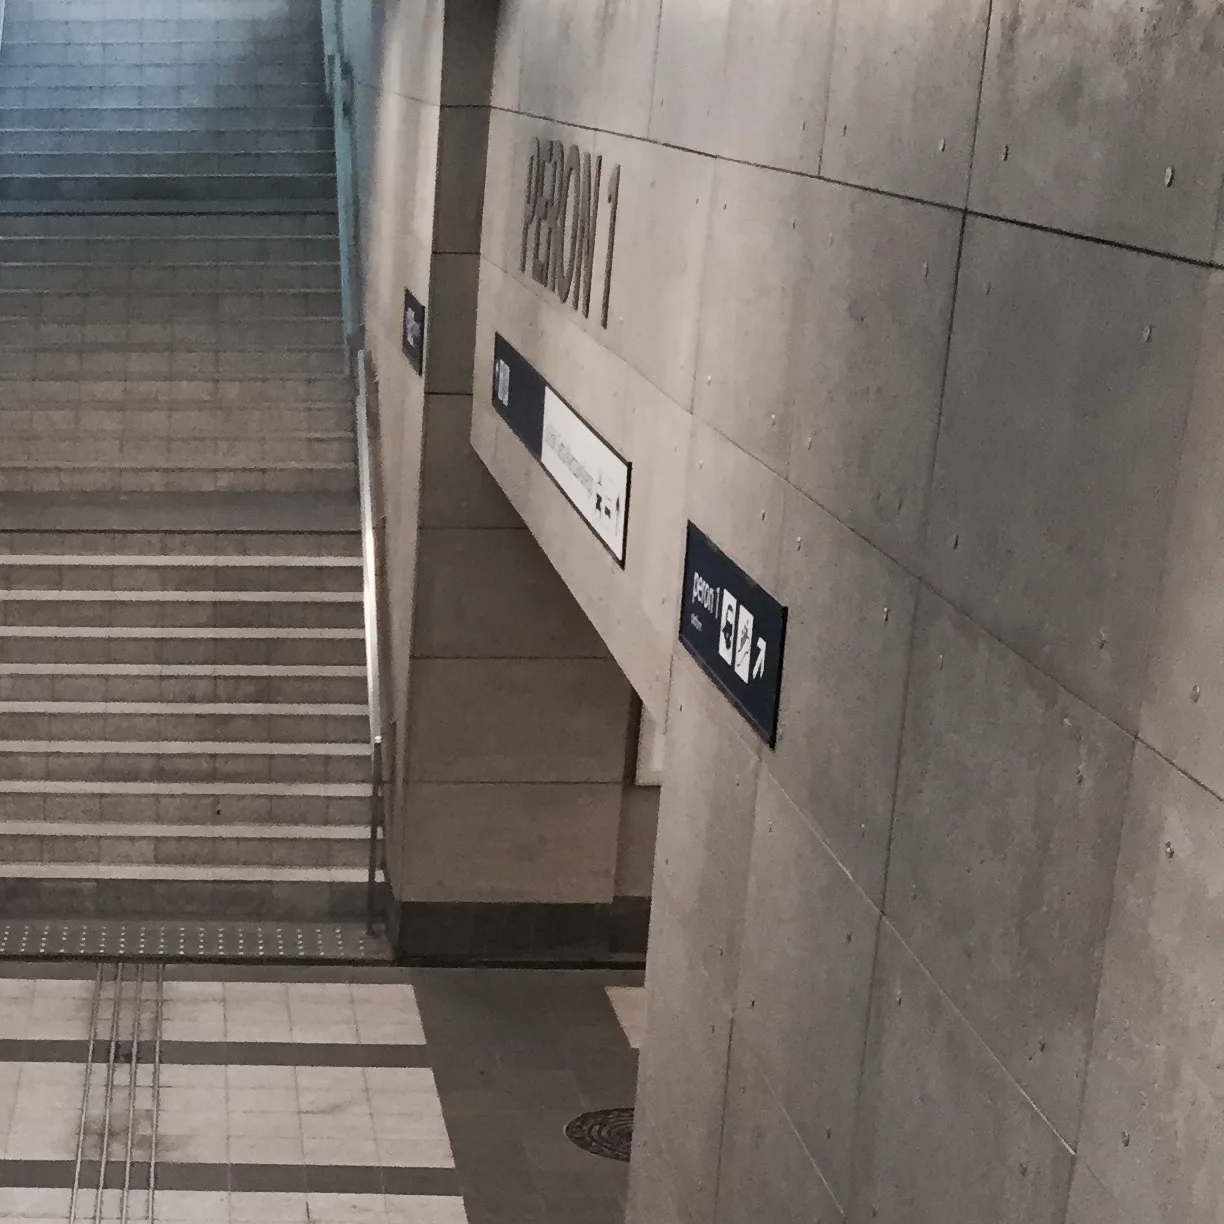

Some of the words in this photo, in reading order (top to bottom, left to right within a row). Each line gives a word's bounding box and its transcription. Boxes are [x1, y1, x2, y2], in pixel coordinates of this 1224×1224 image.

[520, 137, 603, 319] PERON
[600, 163, 621, 330] 1
[691, 571, 714, 614] peron
